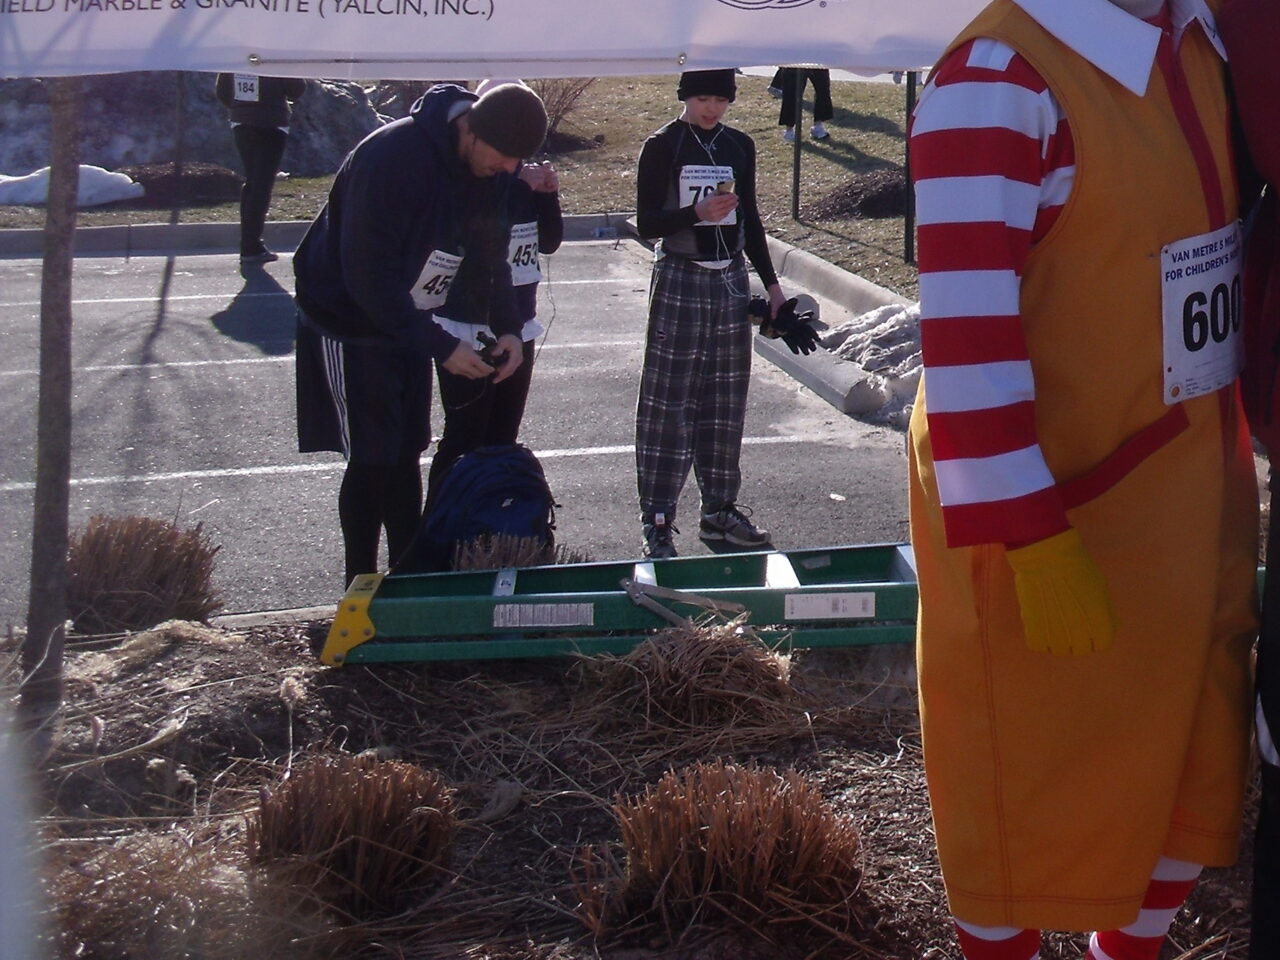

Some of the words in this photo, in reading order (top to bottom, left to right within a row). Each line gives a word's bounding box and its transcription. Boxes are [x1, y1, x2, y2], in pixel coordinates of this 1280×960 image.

[238, 82, 254, 93] 184
[1172, 250, 1190, 263] VAN
[1192, 242, 1219, 259] METRE
[1219, 240, 1224, 251] 5
[1165, 268, 1183, 283] FOR
[1185, 254, 1228, 277] CHILDREN'S
[1182, 273, 1241, 353] 600
